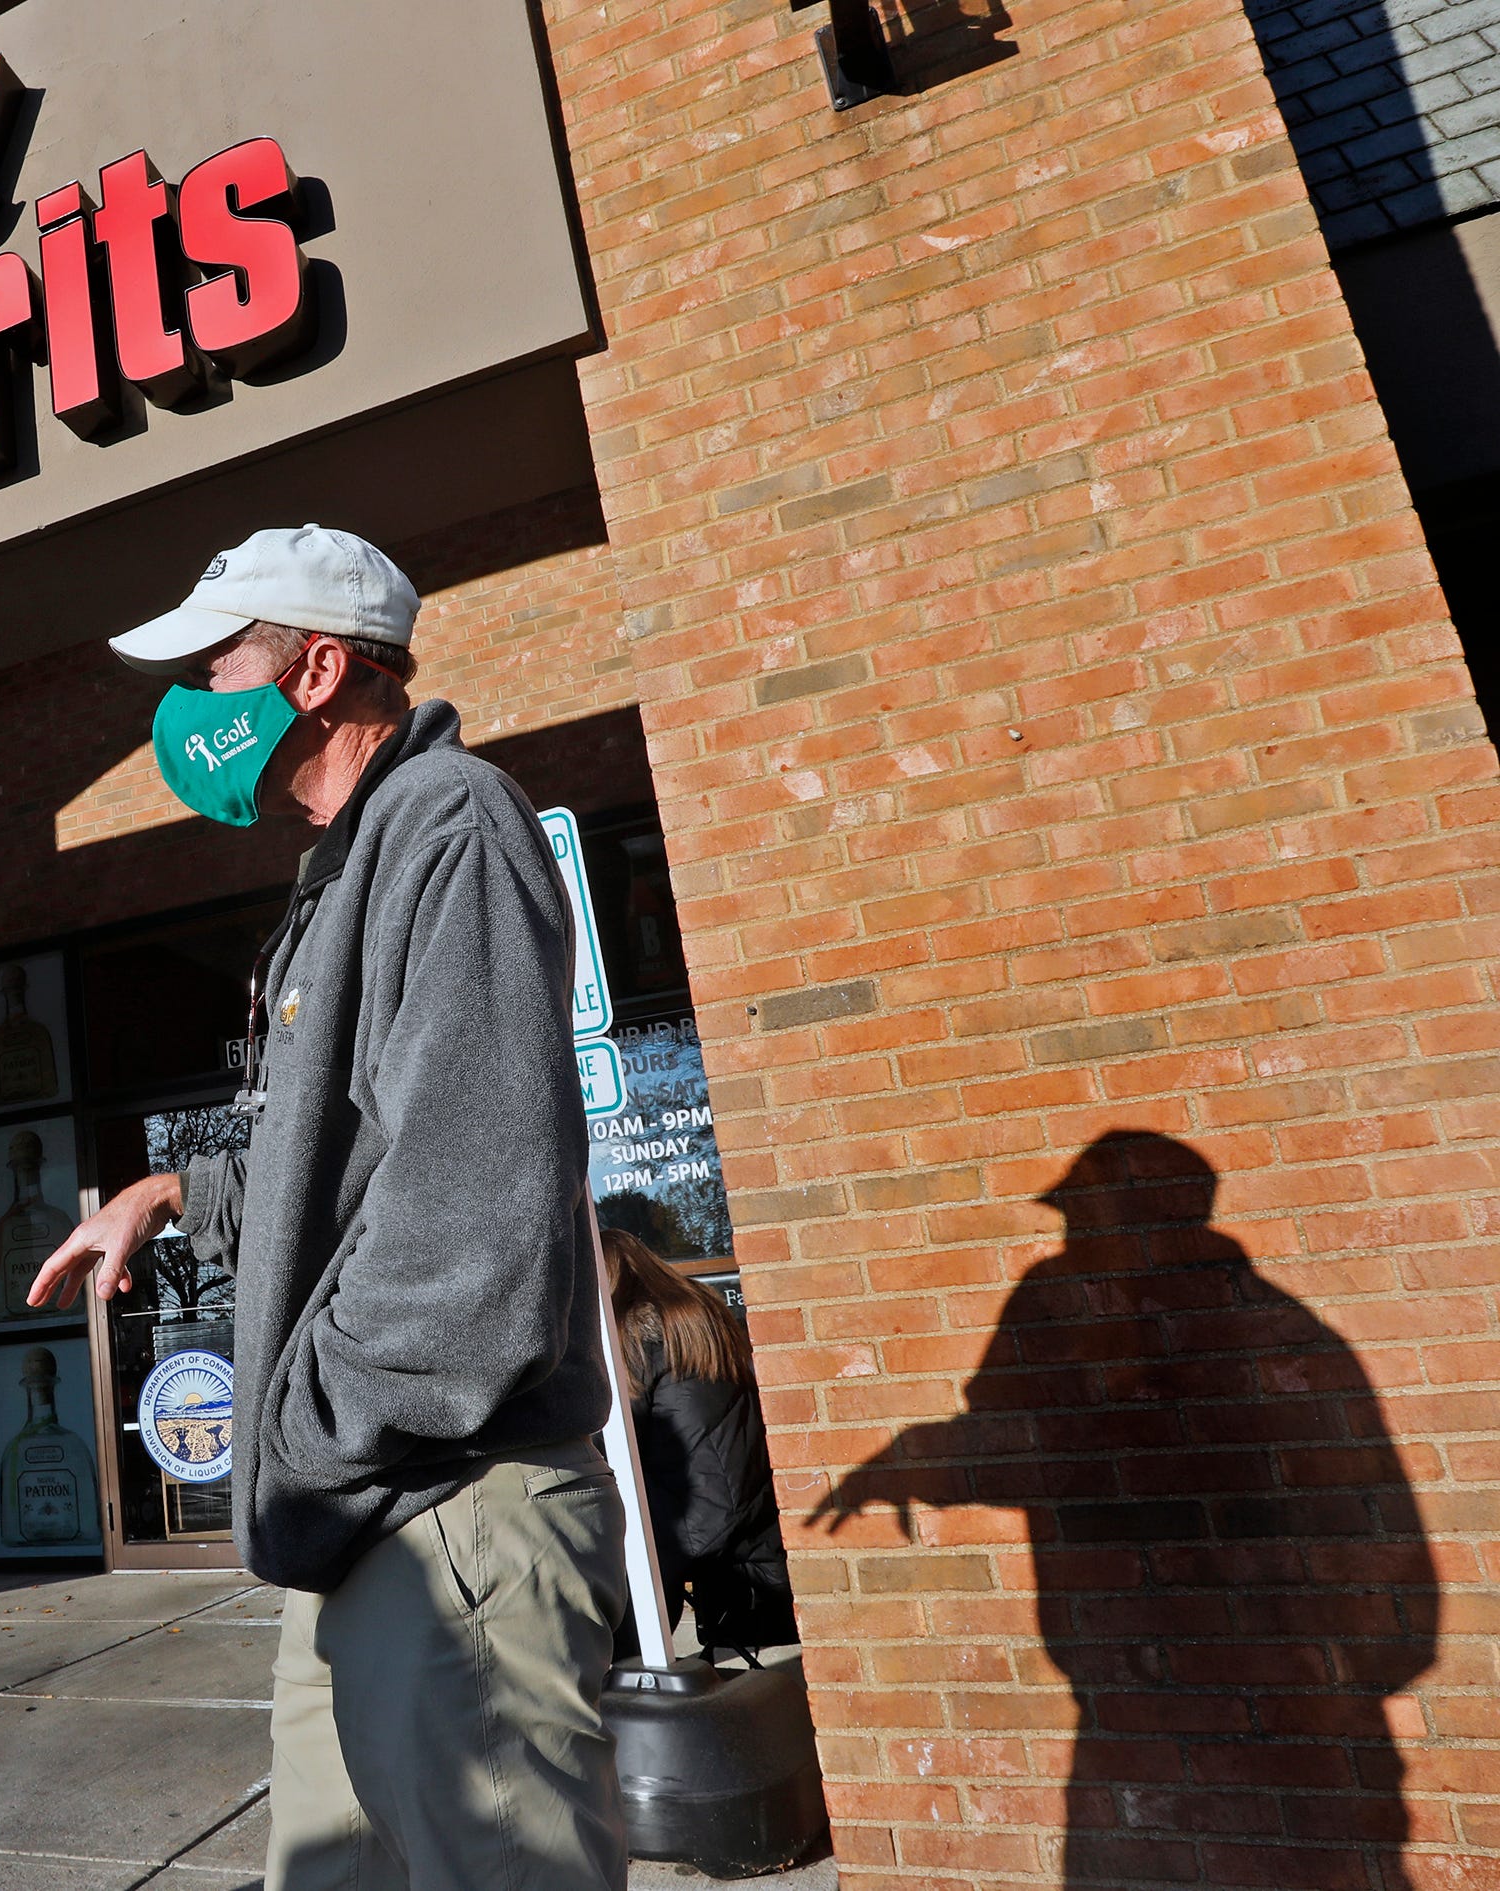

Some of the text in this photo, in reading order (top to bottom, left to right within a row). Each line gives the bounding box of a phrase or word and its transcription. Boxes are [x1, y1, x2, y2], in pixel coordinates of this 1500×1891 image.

[213, 711, 252, 750] Golf
[661, 1106, 713, 1132] 9PM
[611, 1136, 690, 1165] SUNDAY
[602, 1169, 653, 1192] 12PM
[667, 1160, 710, 1183] 5PM
[11, 1261, 42, 1276] PATR
[144, 1355, 234, 1406] DEPARTMENT OF COMME
[145, 1429, 224, 1477] DIVISION OF LIQUOR
